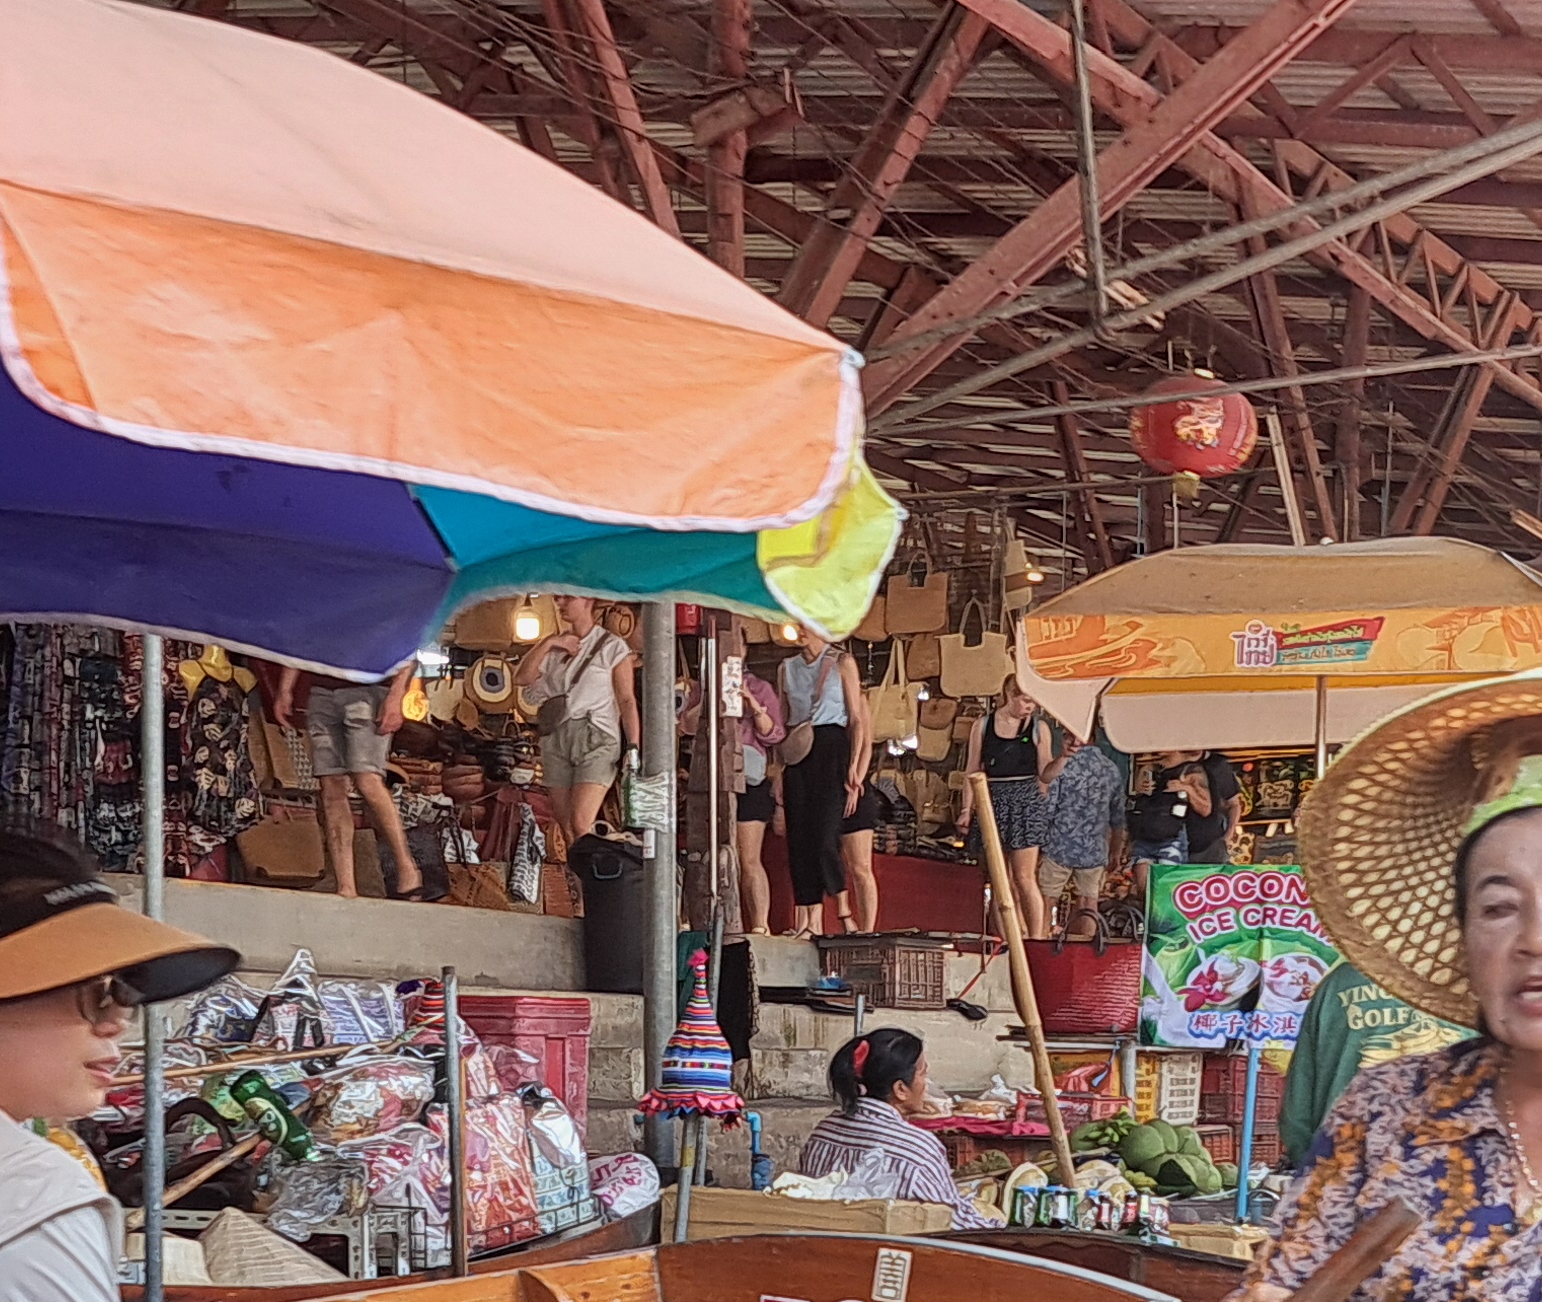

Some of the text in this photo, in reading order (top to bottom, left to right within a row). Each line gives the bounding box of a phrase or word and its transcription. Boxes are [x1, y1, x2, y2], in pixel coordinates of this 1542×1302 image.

[1176, 872, 1309, 912] COCON
[1187, 910, 1236, 943] ICE
[1191, 1011, 1299, 1036] 椰子冰淇
